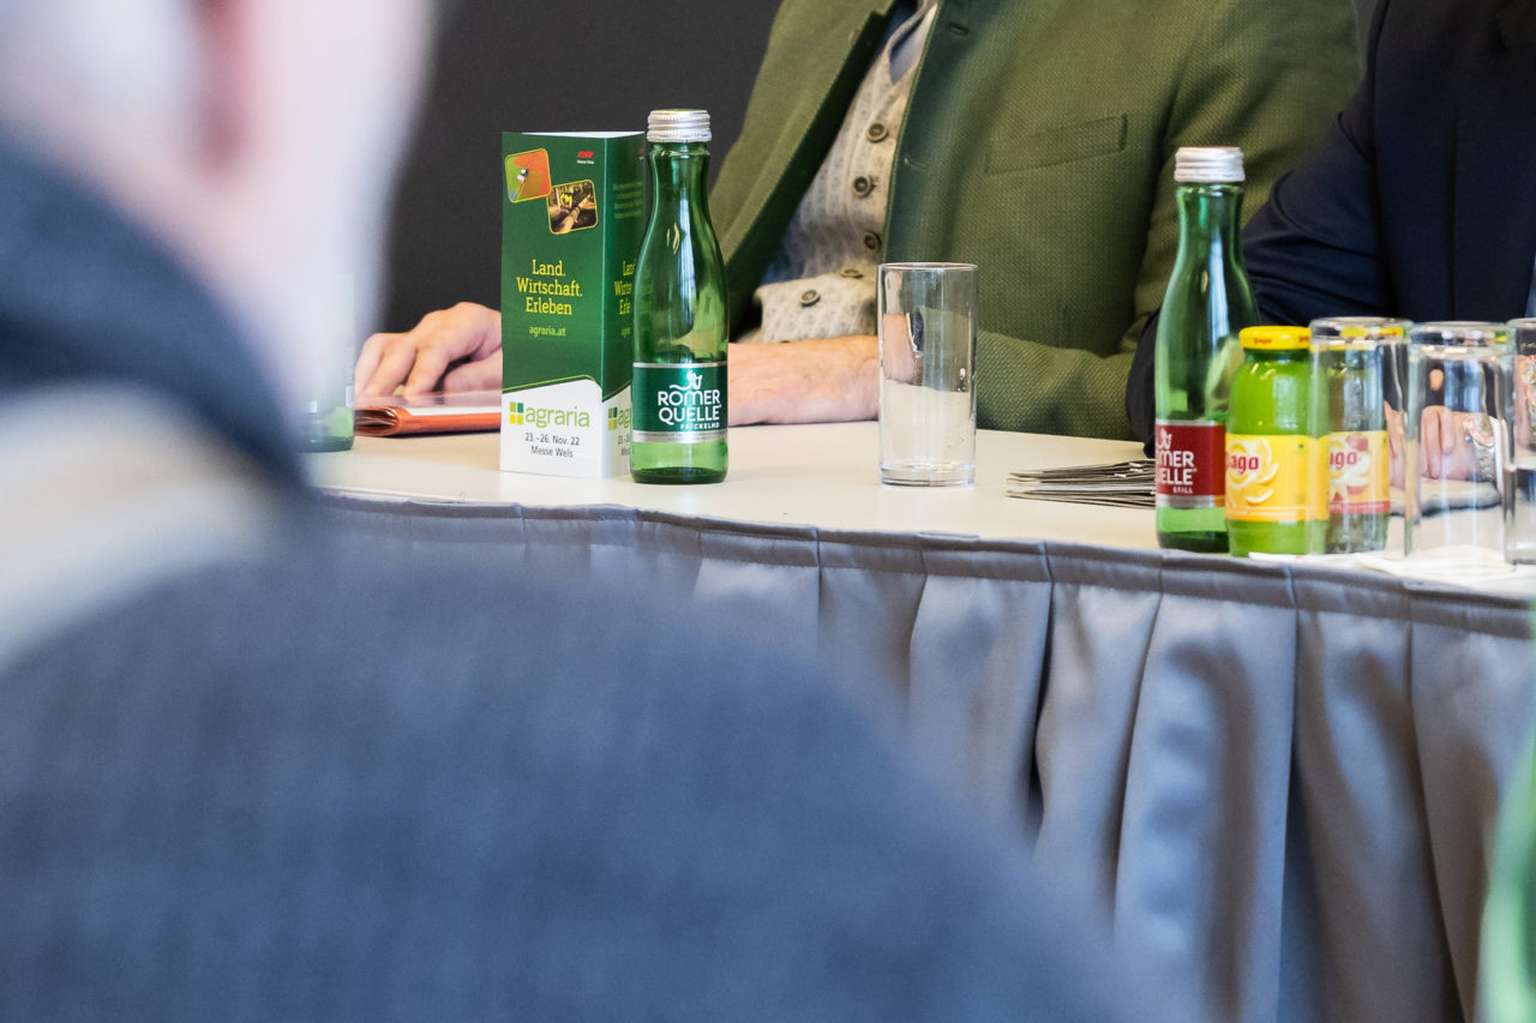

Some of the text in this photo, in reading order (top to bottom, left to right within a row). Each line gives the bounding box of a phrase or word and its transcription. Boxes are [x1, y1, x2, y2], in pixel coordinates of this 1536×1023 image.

[532, 257, 566, 277] Land.
[516, 276, 583, 297] Wirtschaft.
[525, 296, 573, 316] Erleben
[525, 405, 591, 429] agraria
[658, 405, 720, 426] QUELLE
